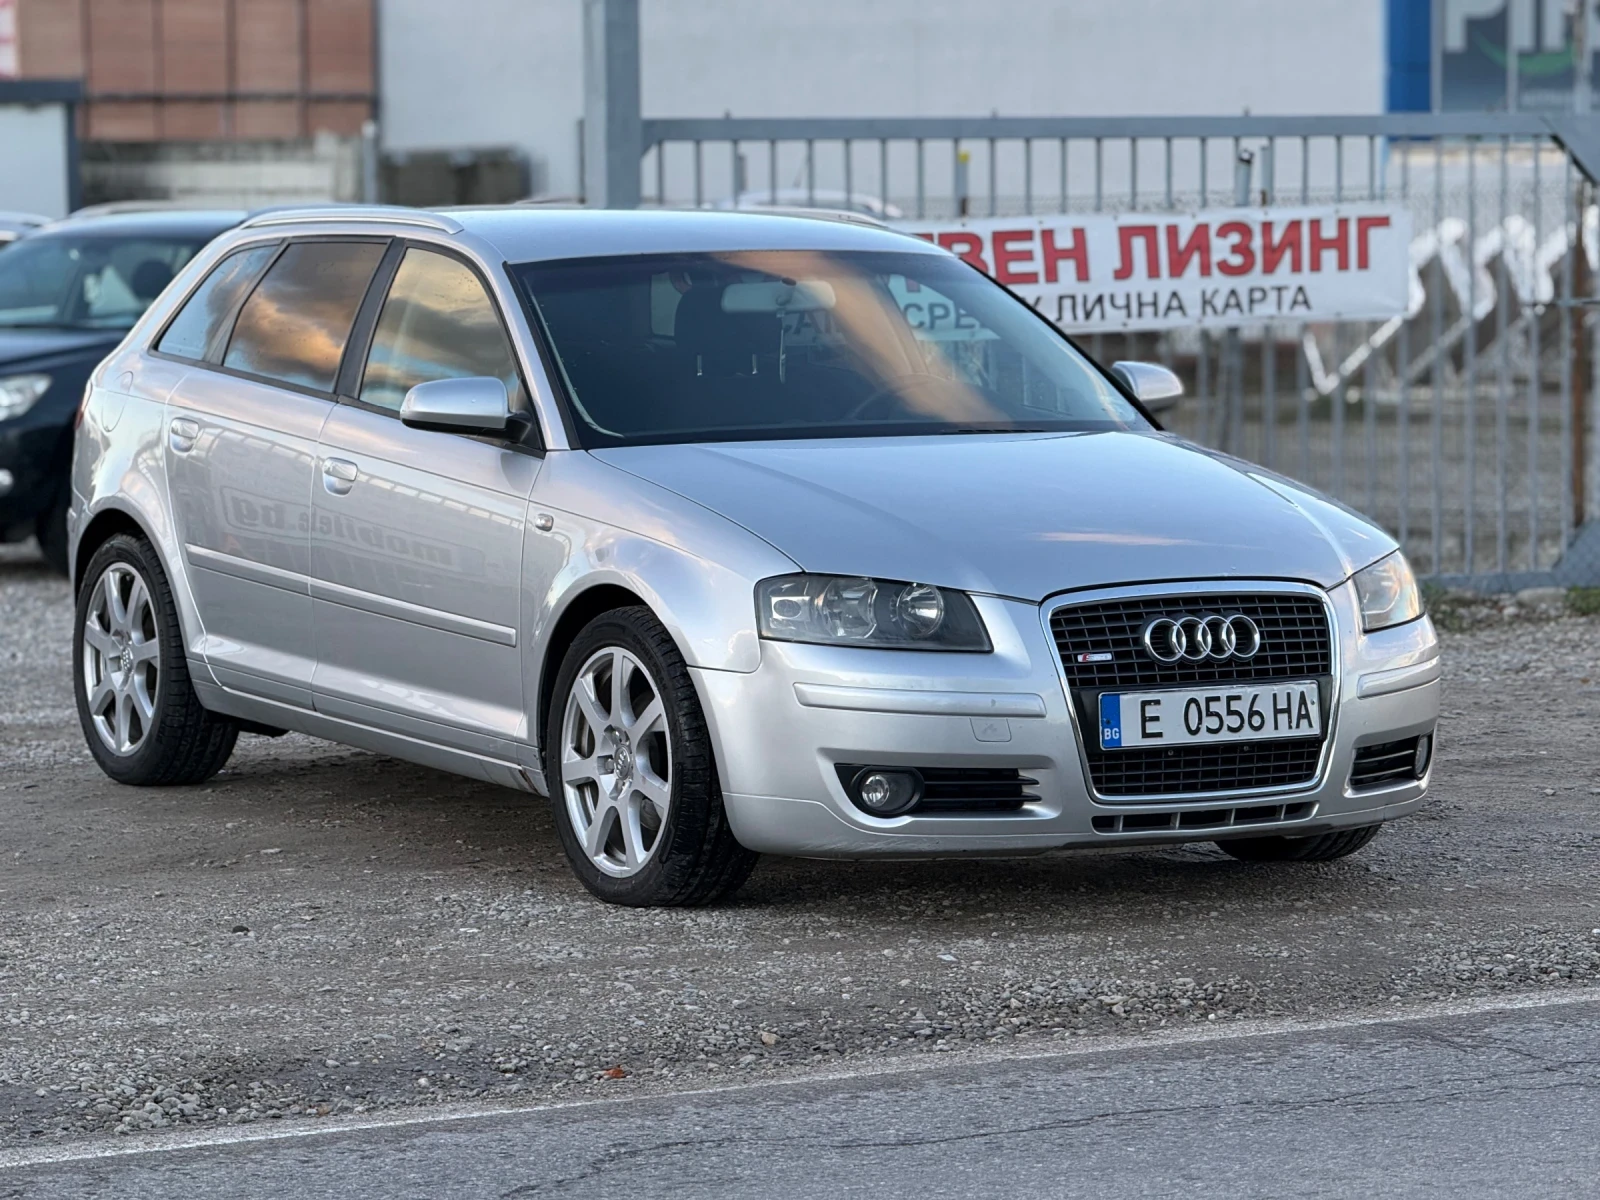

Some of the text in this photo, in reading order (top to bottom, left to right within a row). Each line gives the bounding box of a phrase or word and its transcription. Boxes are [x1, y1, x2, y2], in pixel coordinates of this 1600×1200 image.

[1113, 216, 1391, 281] ЛИЗИНГ
[1055, 290, 1188, 323] ЛИЧНА
[1201, 285, 1313, 317] КАРТА
[1103, 727, 1121, 741] BG
[1140, 690, 1314, 739] E 0556 HA
